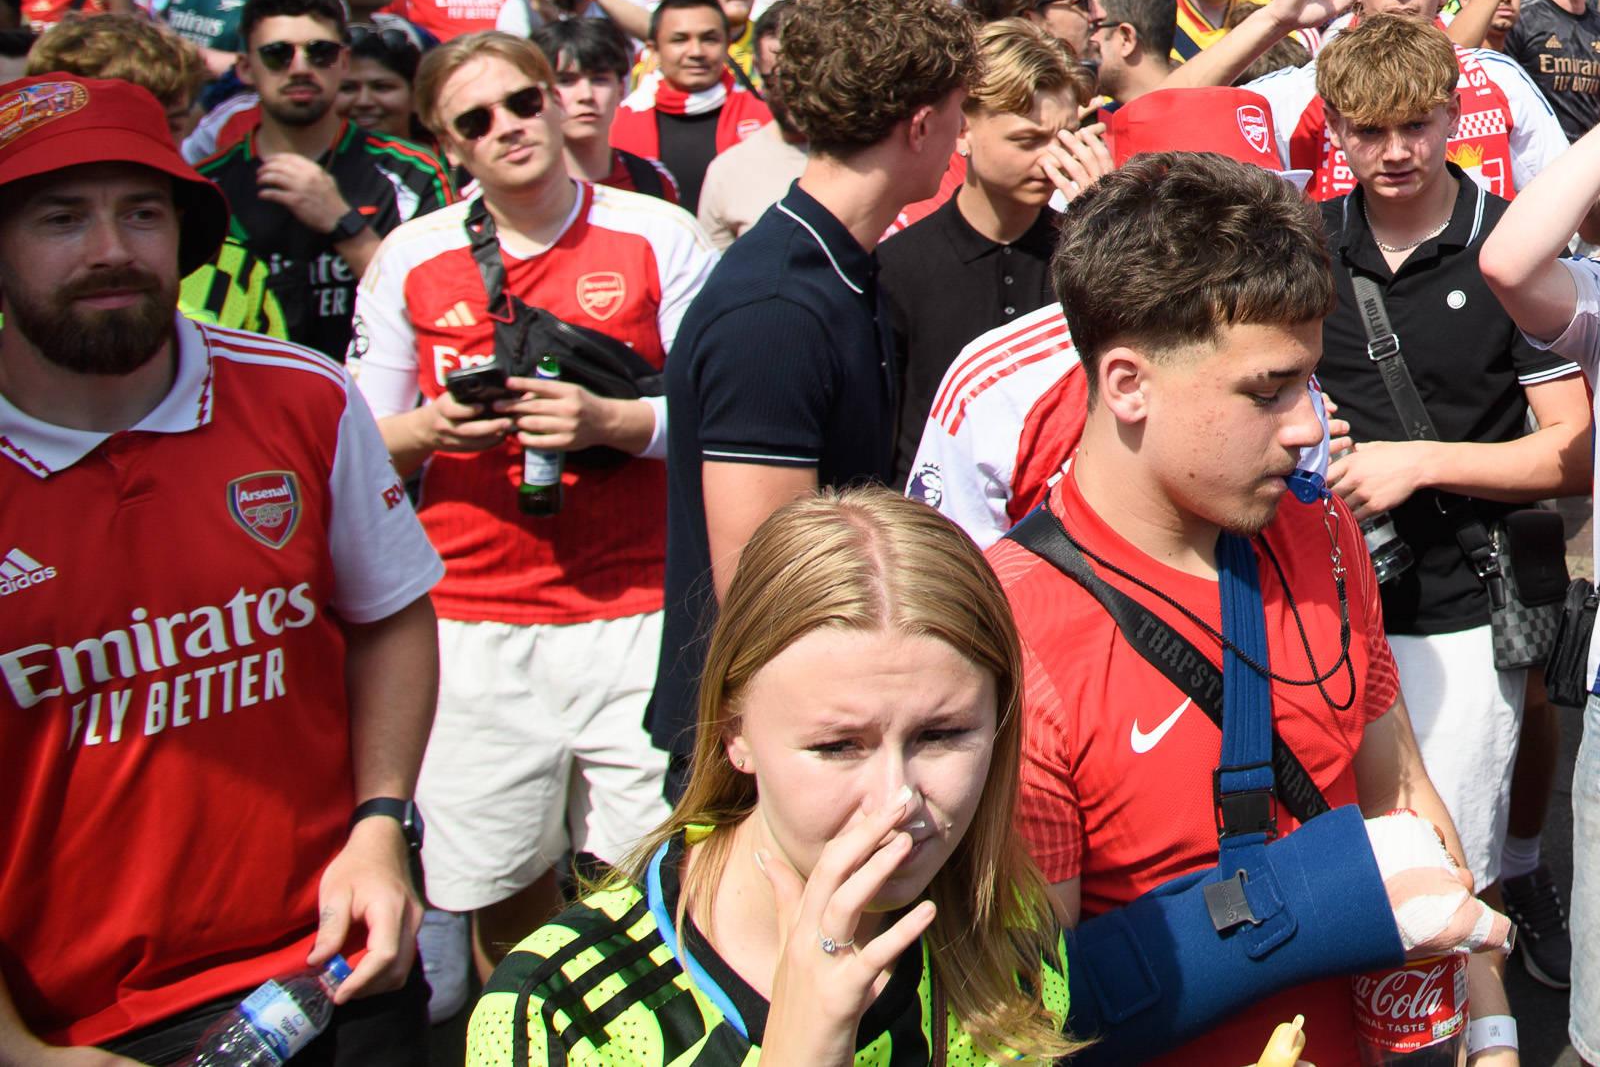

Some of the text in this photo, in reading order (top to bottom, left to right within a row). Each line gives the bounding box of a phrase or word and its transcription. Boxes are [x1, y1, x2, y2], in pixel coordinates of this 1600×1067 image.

[239, 484, 289, 503] Arsenal
[0, 582, 317, 710] Emirates
[66, 647, 287, 751] FLY BETTER
[1387, 1022, 1426, 1033] TASTE
